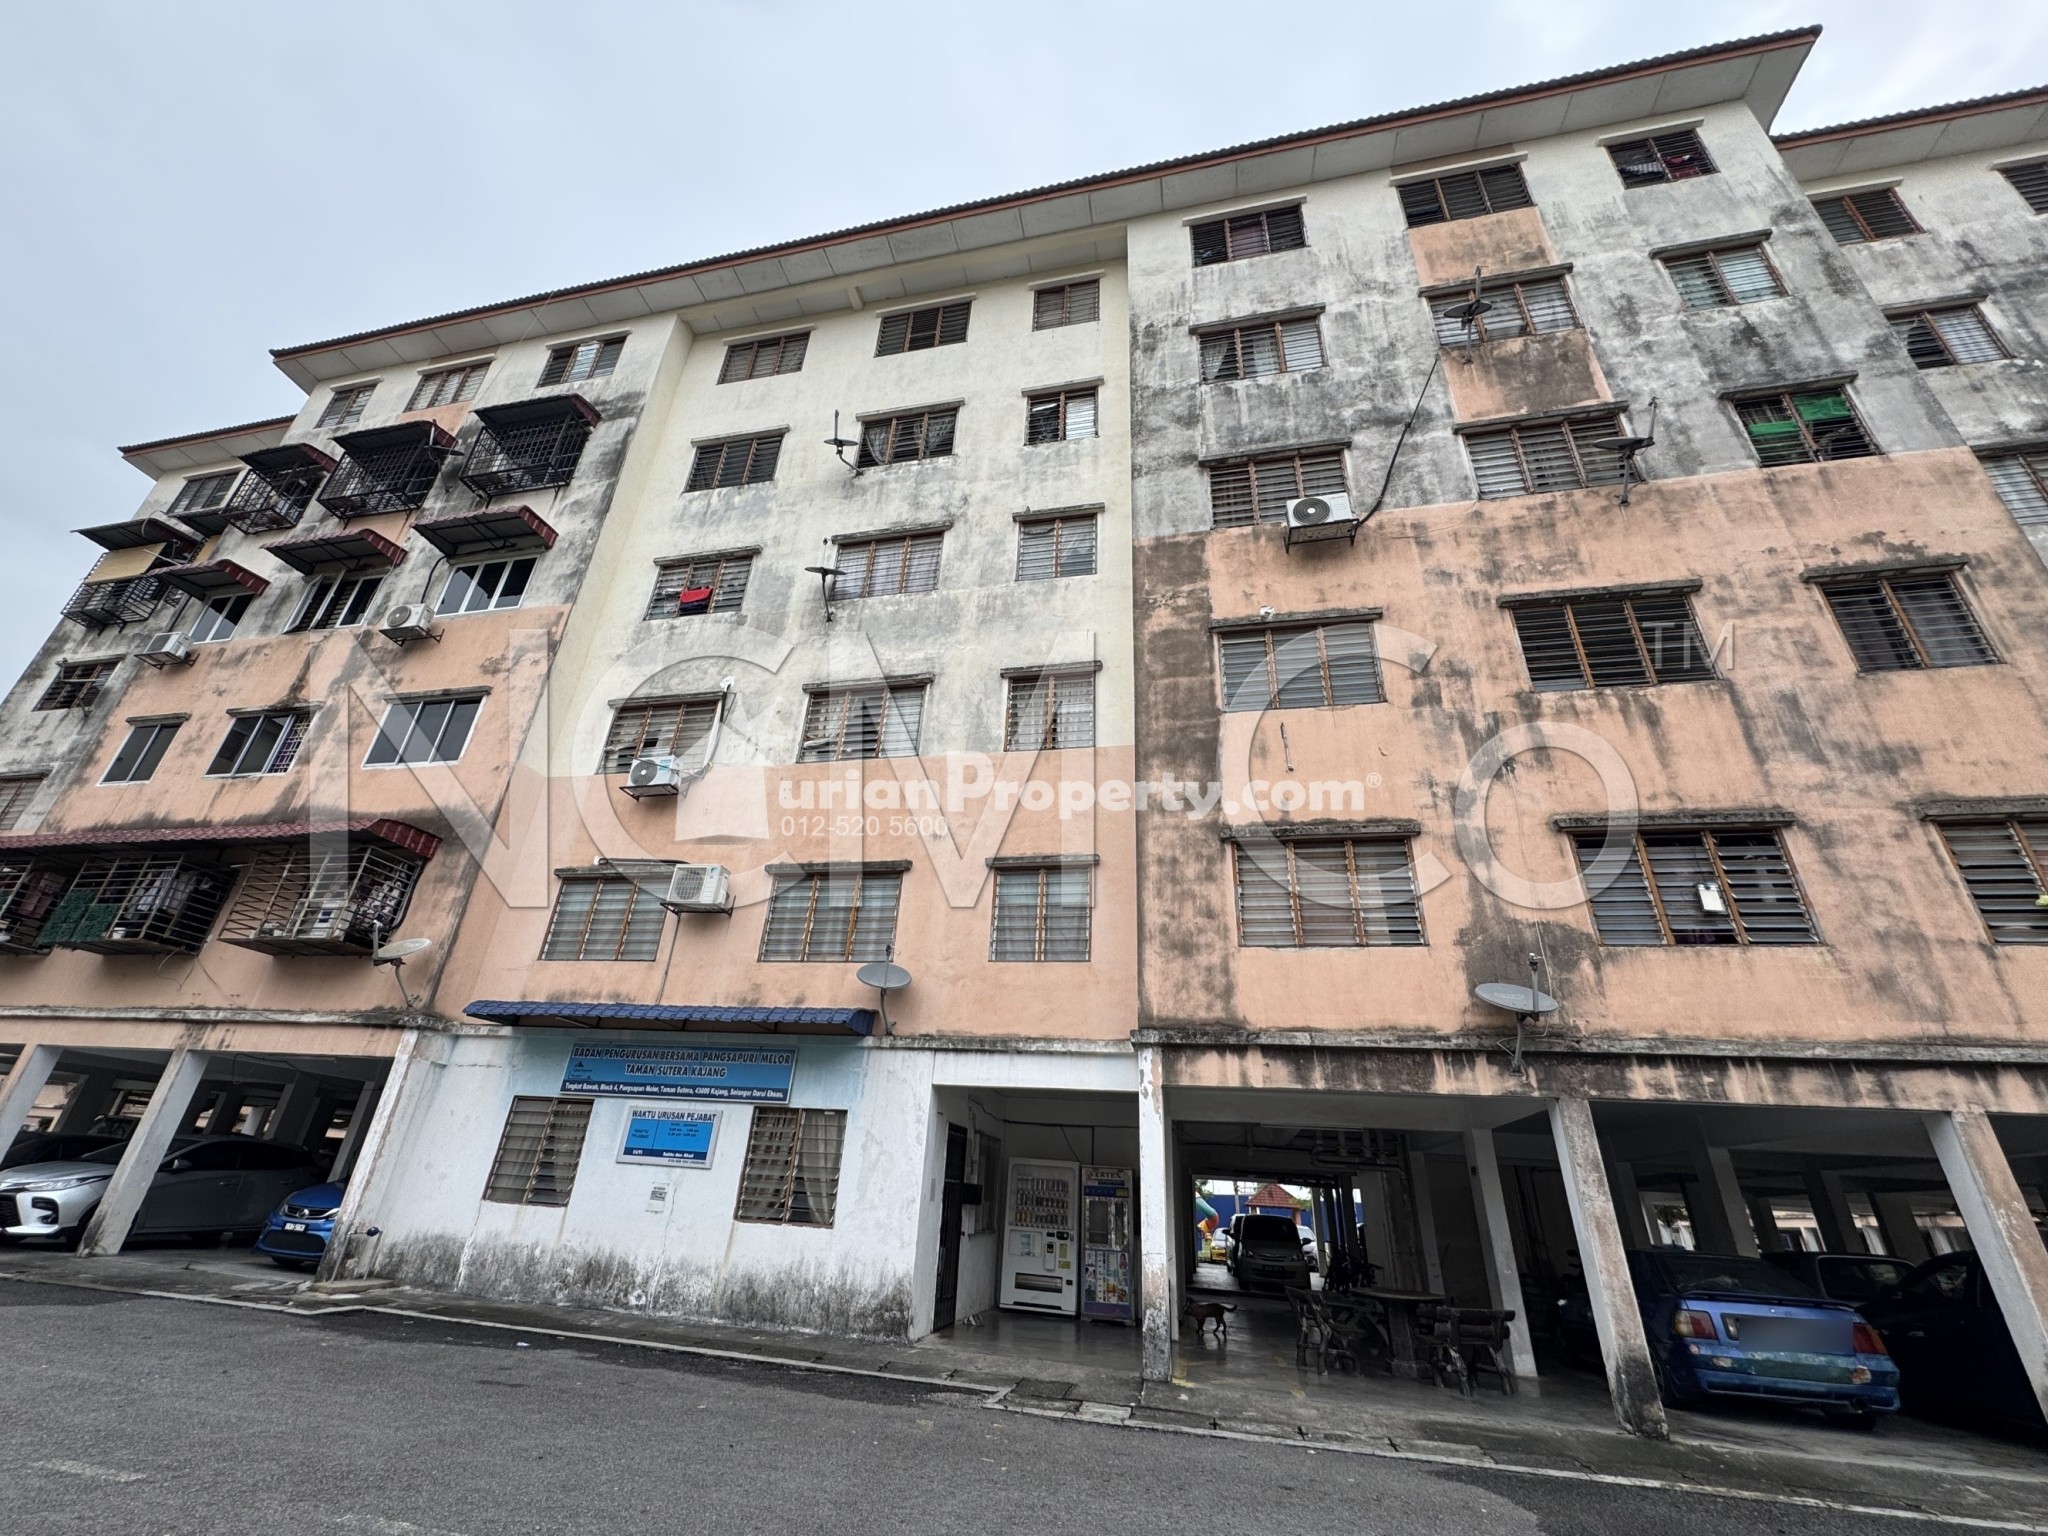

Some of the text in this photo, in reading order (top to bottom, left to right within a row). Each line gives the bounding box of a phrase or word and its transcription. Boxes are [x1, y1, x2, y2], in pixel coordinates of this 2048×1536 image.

[573, 1047, 791, 1065] BADAN PENGURUSAN BERSAMA PANGSAPURI MELOR
[625, 1063, 727, 1079] TAMAN SUTERA KAJANG
[565, 1082, 582, 1090] Tingkat
[730, 1088, 752, 1097] Selangor
[632, 1110, 717, 1122] WAKTU URUSAN PEJABAT
